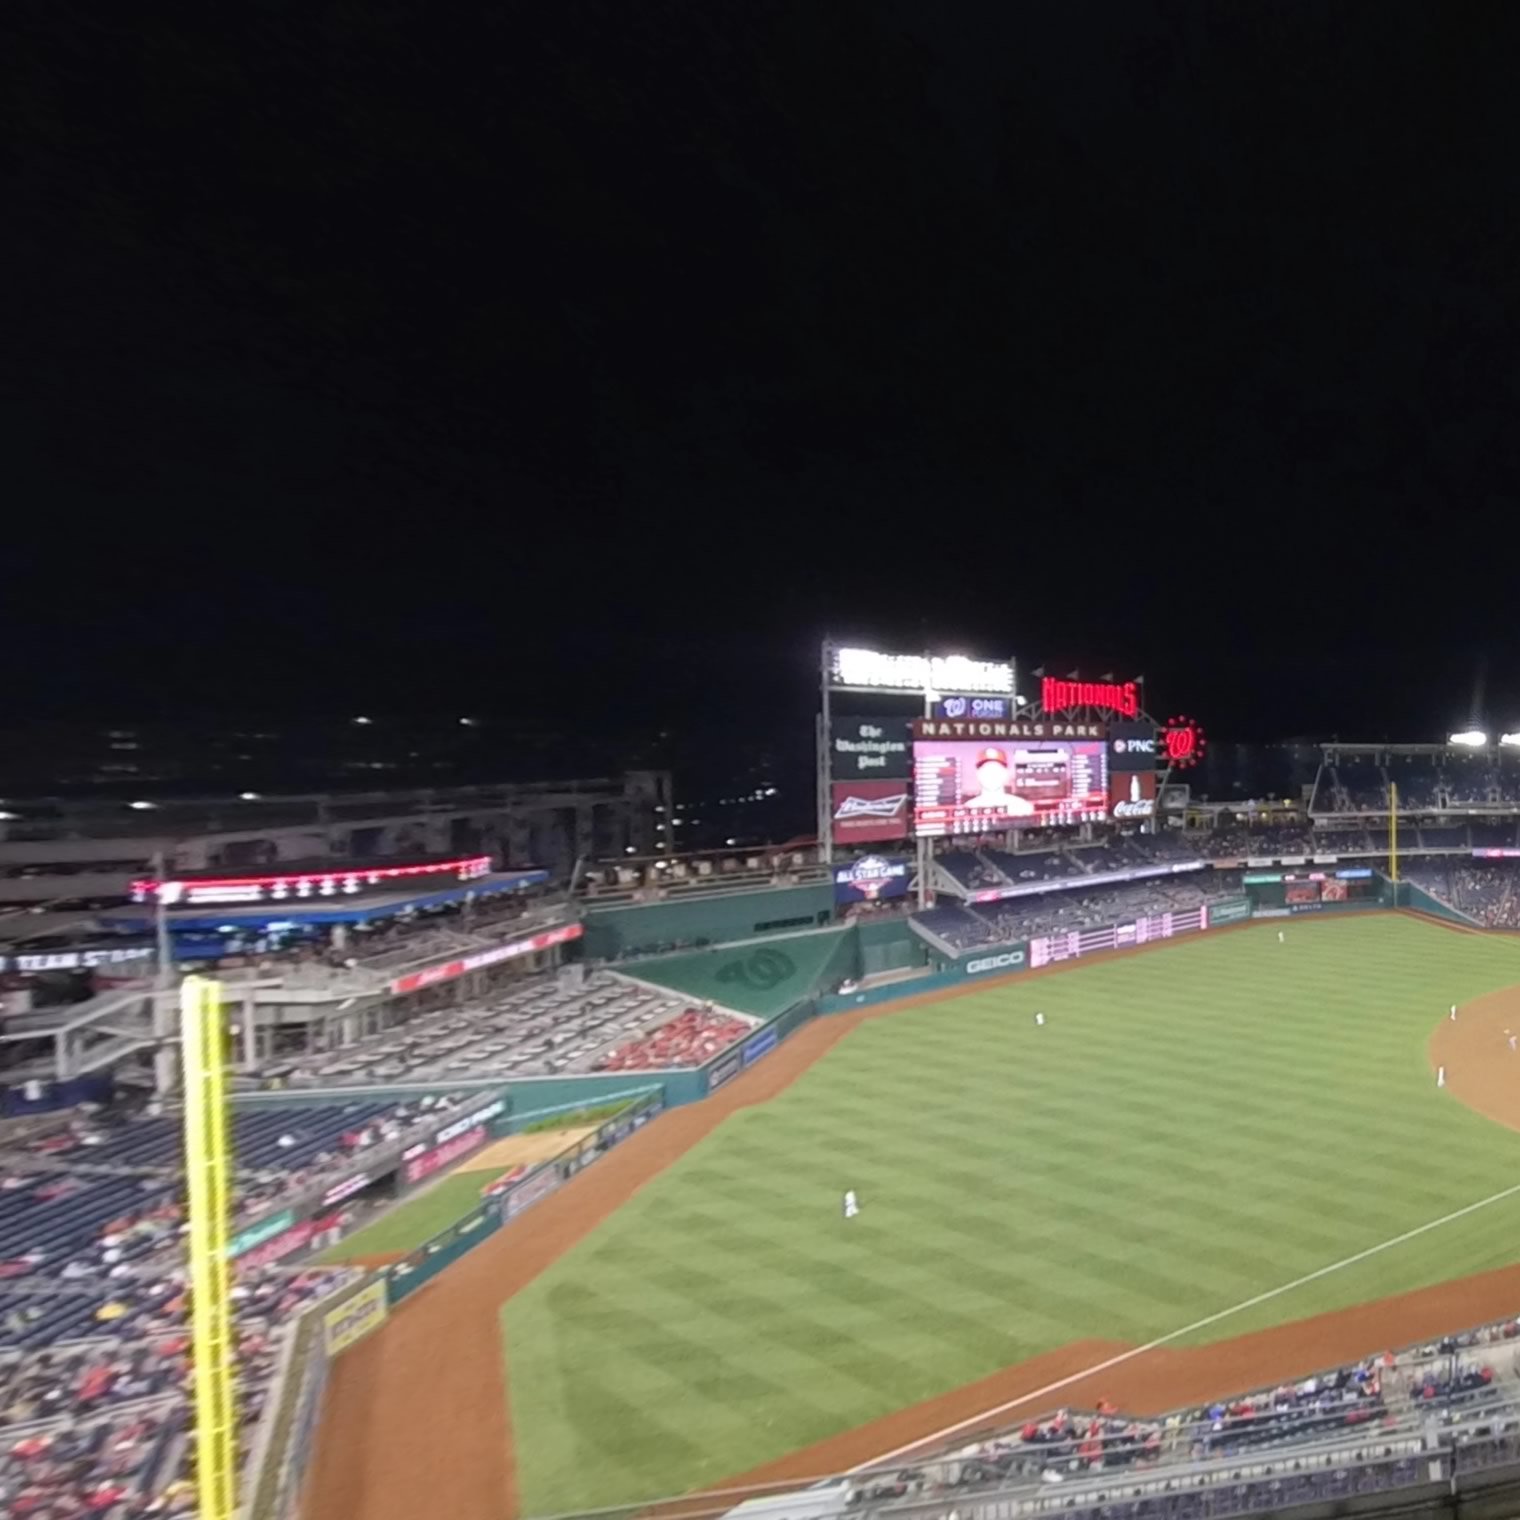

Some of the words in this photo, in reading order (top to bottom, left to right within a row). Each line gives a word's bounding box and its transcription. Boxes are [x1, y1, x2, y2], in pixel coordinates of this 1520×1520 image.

[1042, 676, 1138, 717] NATIONALS
[971, 699, 1003, 711] ONE
[859, 725, 882, 738] The
[922, 723, 1044, 736] NATIONALS
[1053, 725, 1098, 736] PARK
[835, 738, 905, 754] Washington
[1127, 740, 1155, 752] PNC
[1166, 727, 1194, 759] W
[858, 755, 886, 770] Post
[966, 951, 1024, 974] GEICO
